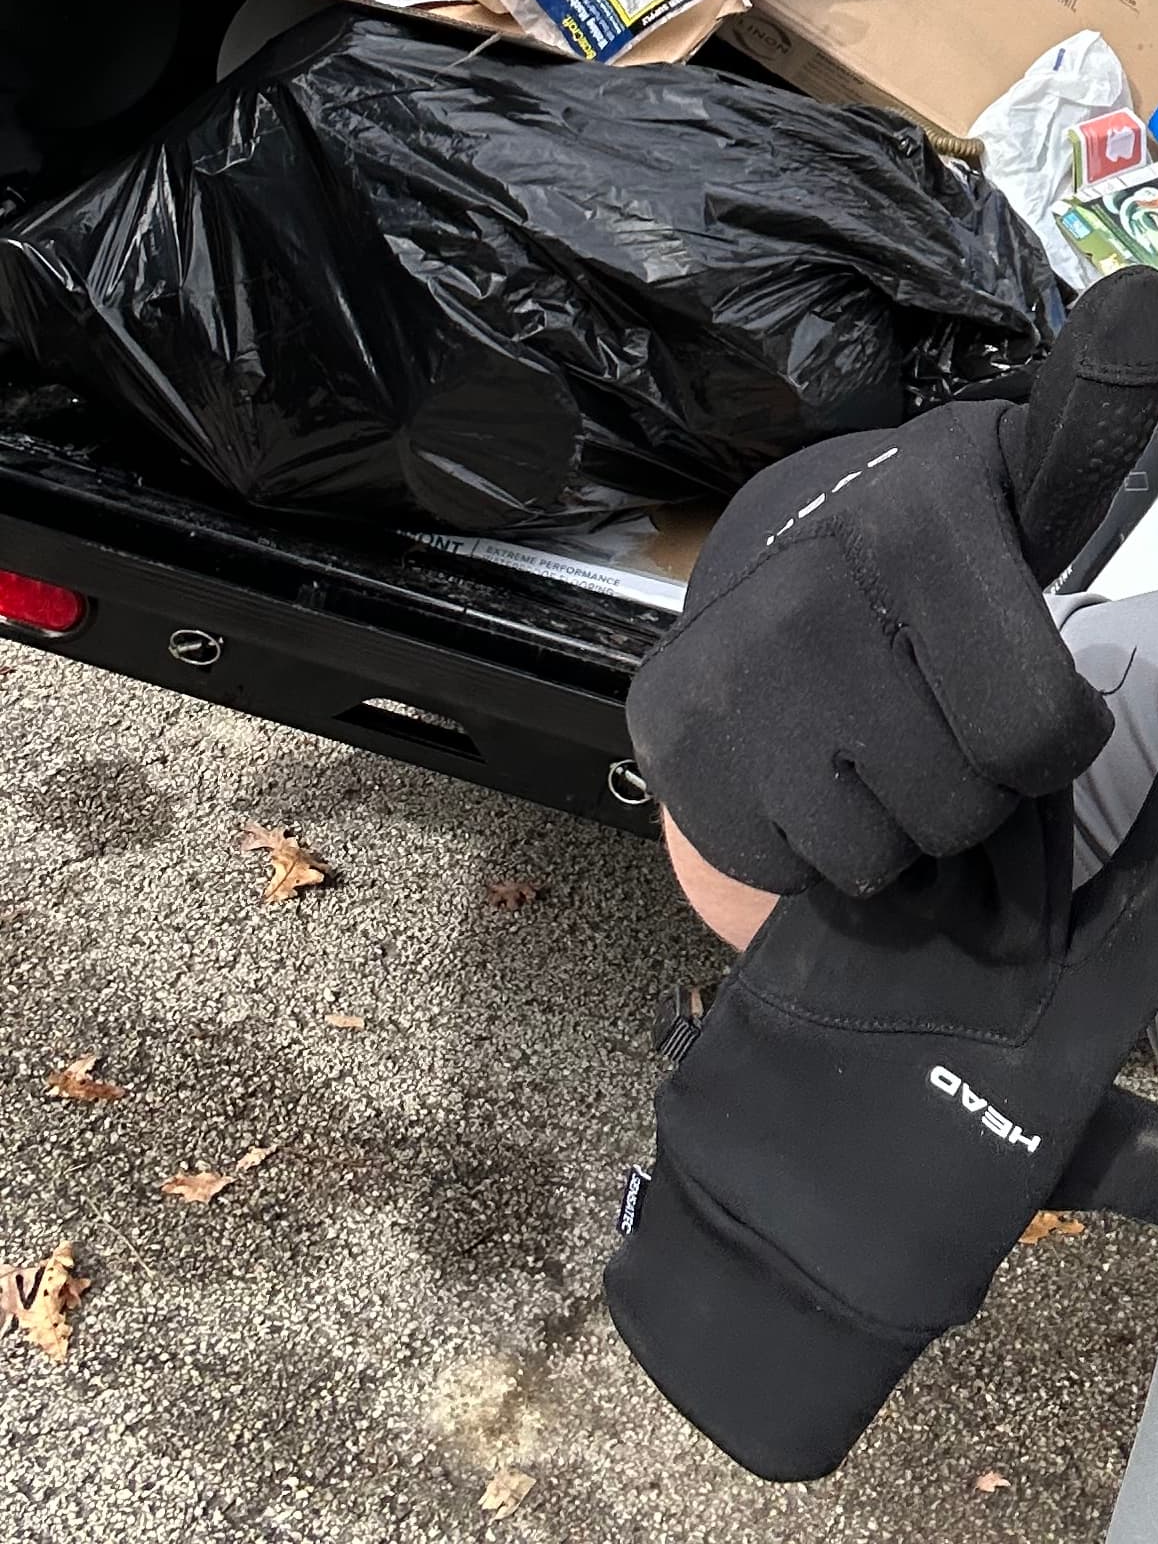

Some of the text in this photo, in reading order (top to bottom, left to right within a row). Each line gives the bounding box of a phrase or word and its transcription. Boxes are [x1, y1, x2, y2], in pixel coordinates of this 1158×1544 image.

[582, 16, 612, 50] Washing
[639, 1, 670, 27] SUPPLY
[485, 545, 537, 565] EXTREME
[538, 558, 621, 586] PERFORMANCE
[929, 1064, 1042, 1153] HEAD
[618, 1172, 644, 1234] SENSATEC
